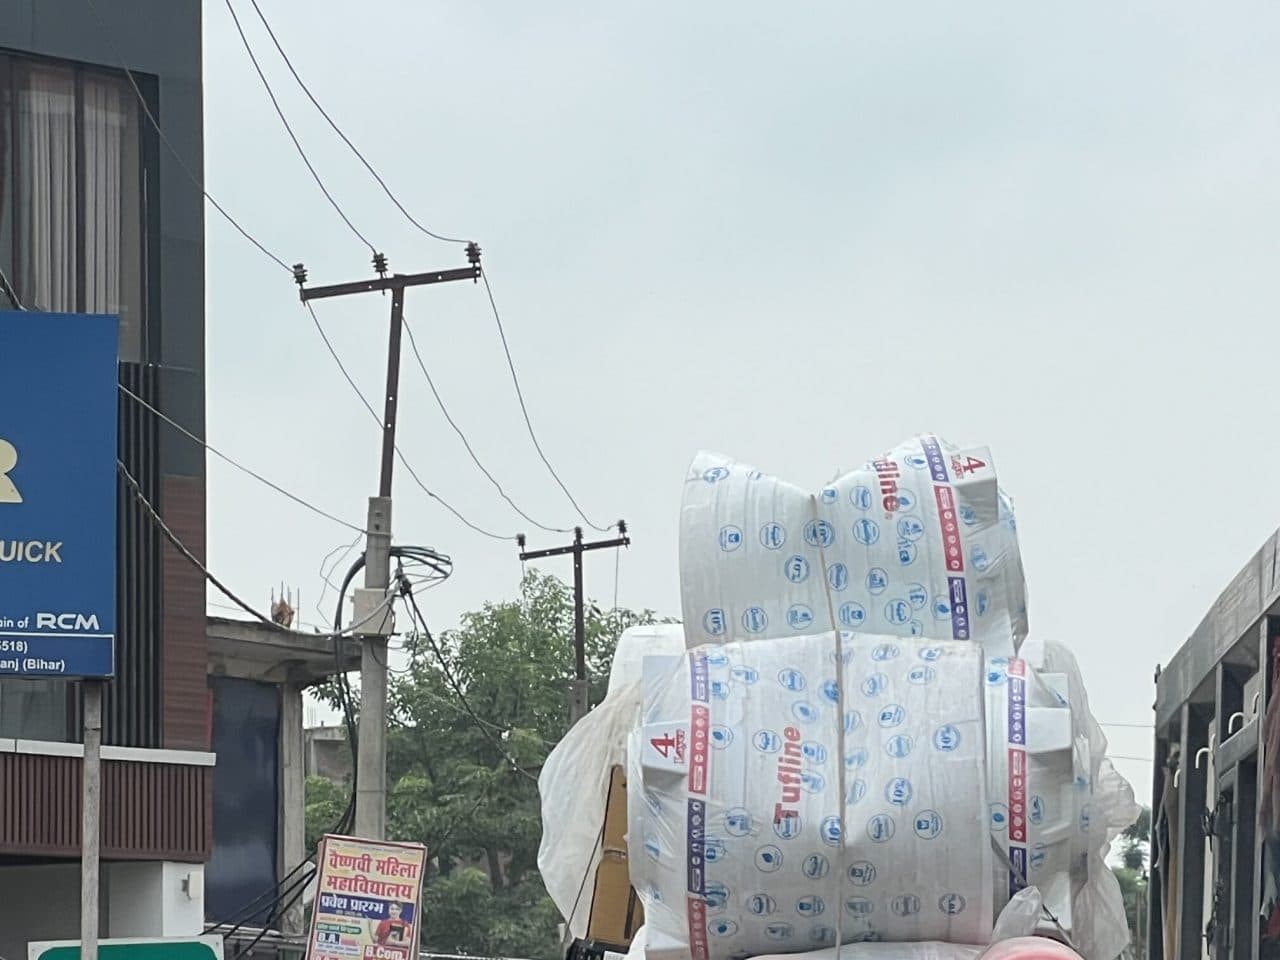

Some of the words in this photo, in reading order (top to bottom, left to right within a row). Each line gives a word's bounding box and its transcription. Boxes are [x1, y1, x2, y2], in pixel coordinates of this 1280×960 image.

[17, 616, 30, 628] of
[36, 613, 100, 631] RCM
[23, 658, 66, 673] (Bihar)
[650, 732, 675, 758] 4
[773, 726, 802, 825] Tufline
[376, 856, 418, 879] महिला
[326, 874, 415, 900] महाविद्यालय
